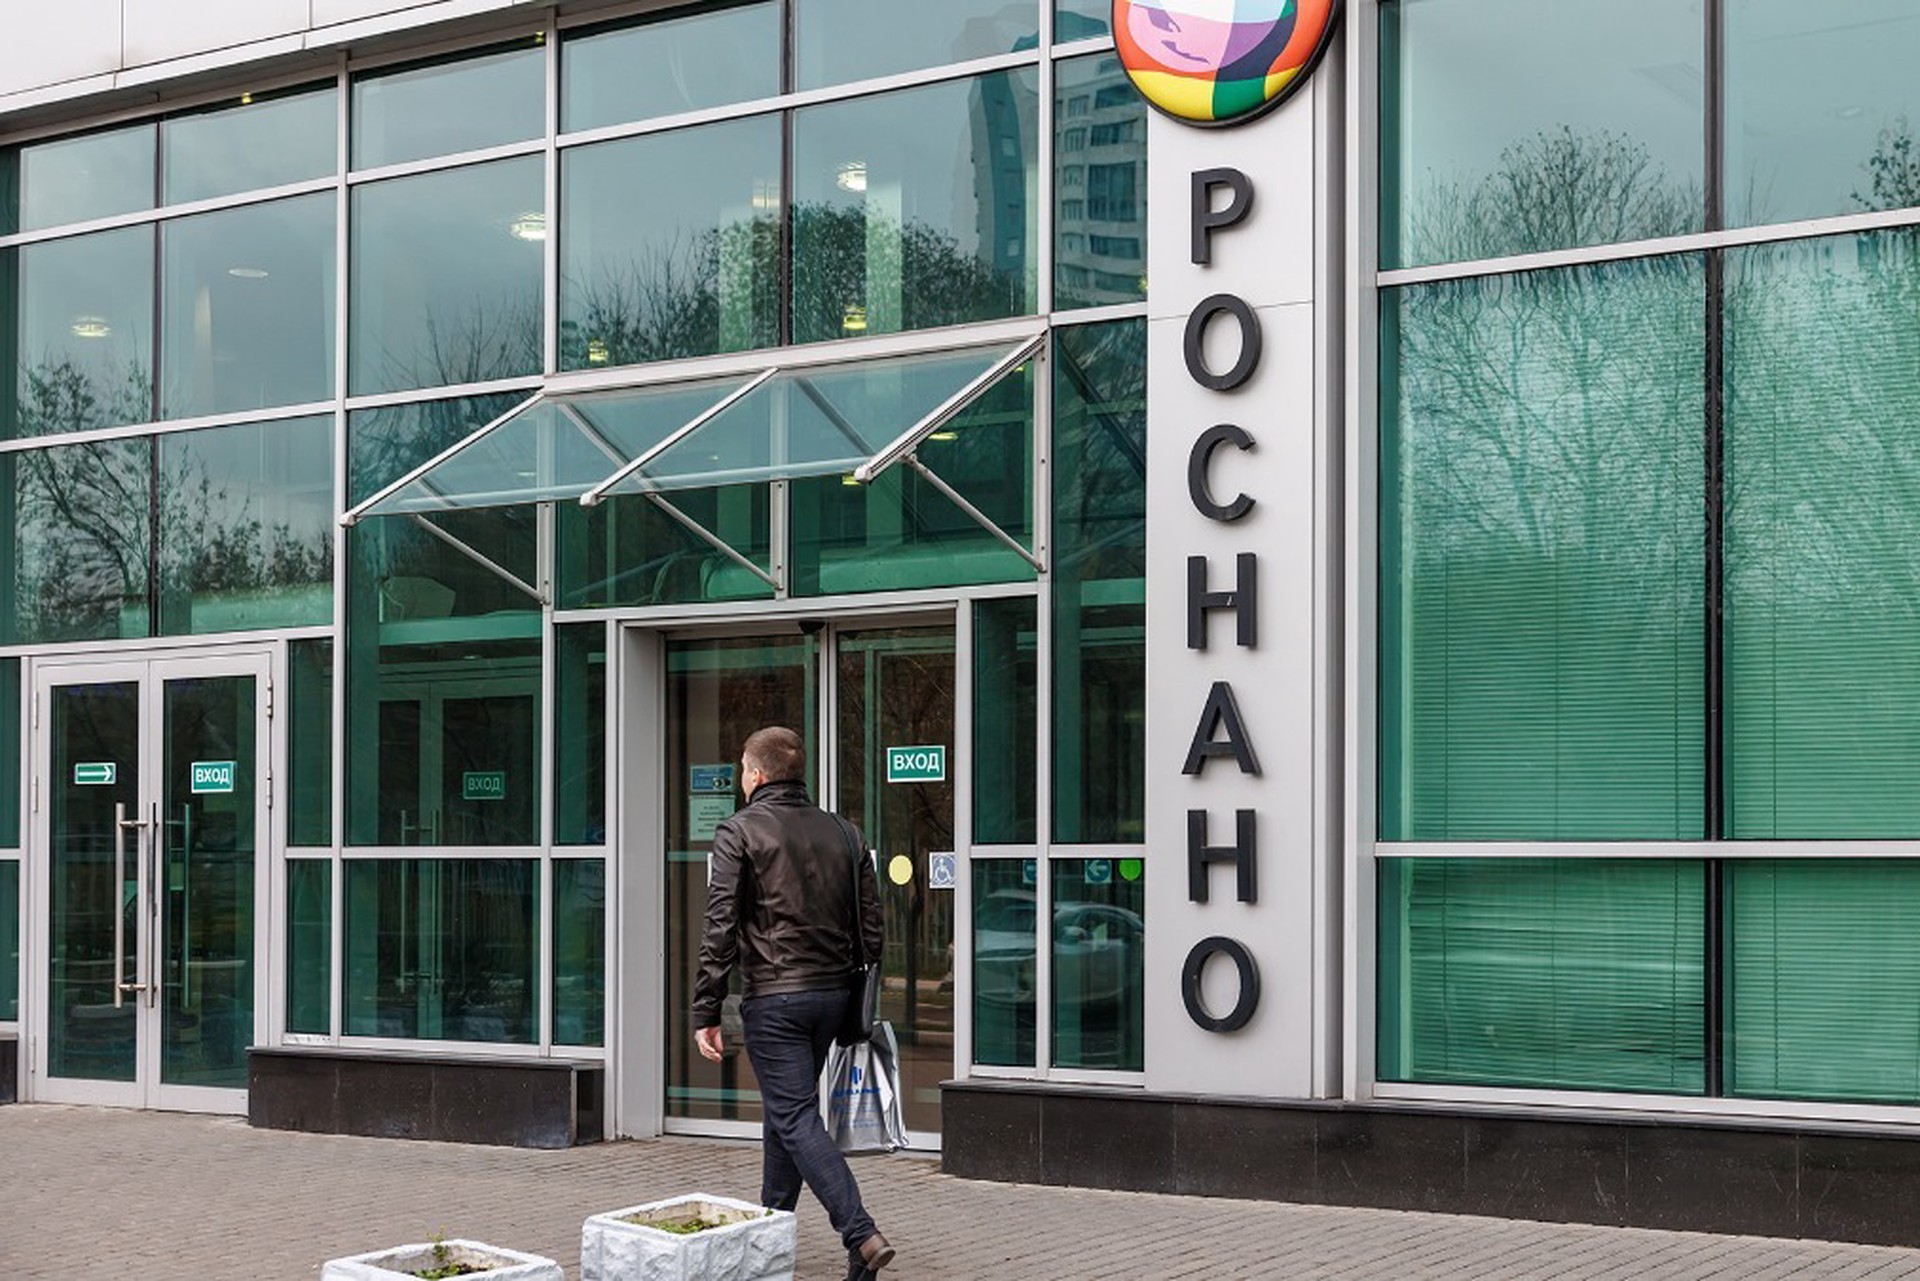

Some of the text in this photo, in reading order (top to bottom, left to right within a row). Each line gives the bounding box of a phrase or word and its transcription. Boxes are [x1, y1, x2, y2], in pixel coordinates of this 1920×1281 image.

[1181, 167, 1262, 1034] РОСНАНО
[893, 752, 940, 773] ВХОД
[195, 767, 231, 785] ВХОД
[468, 777, 501, 793] ВХОД
